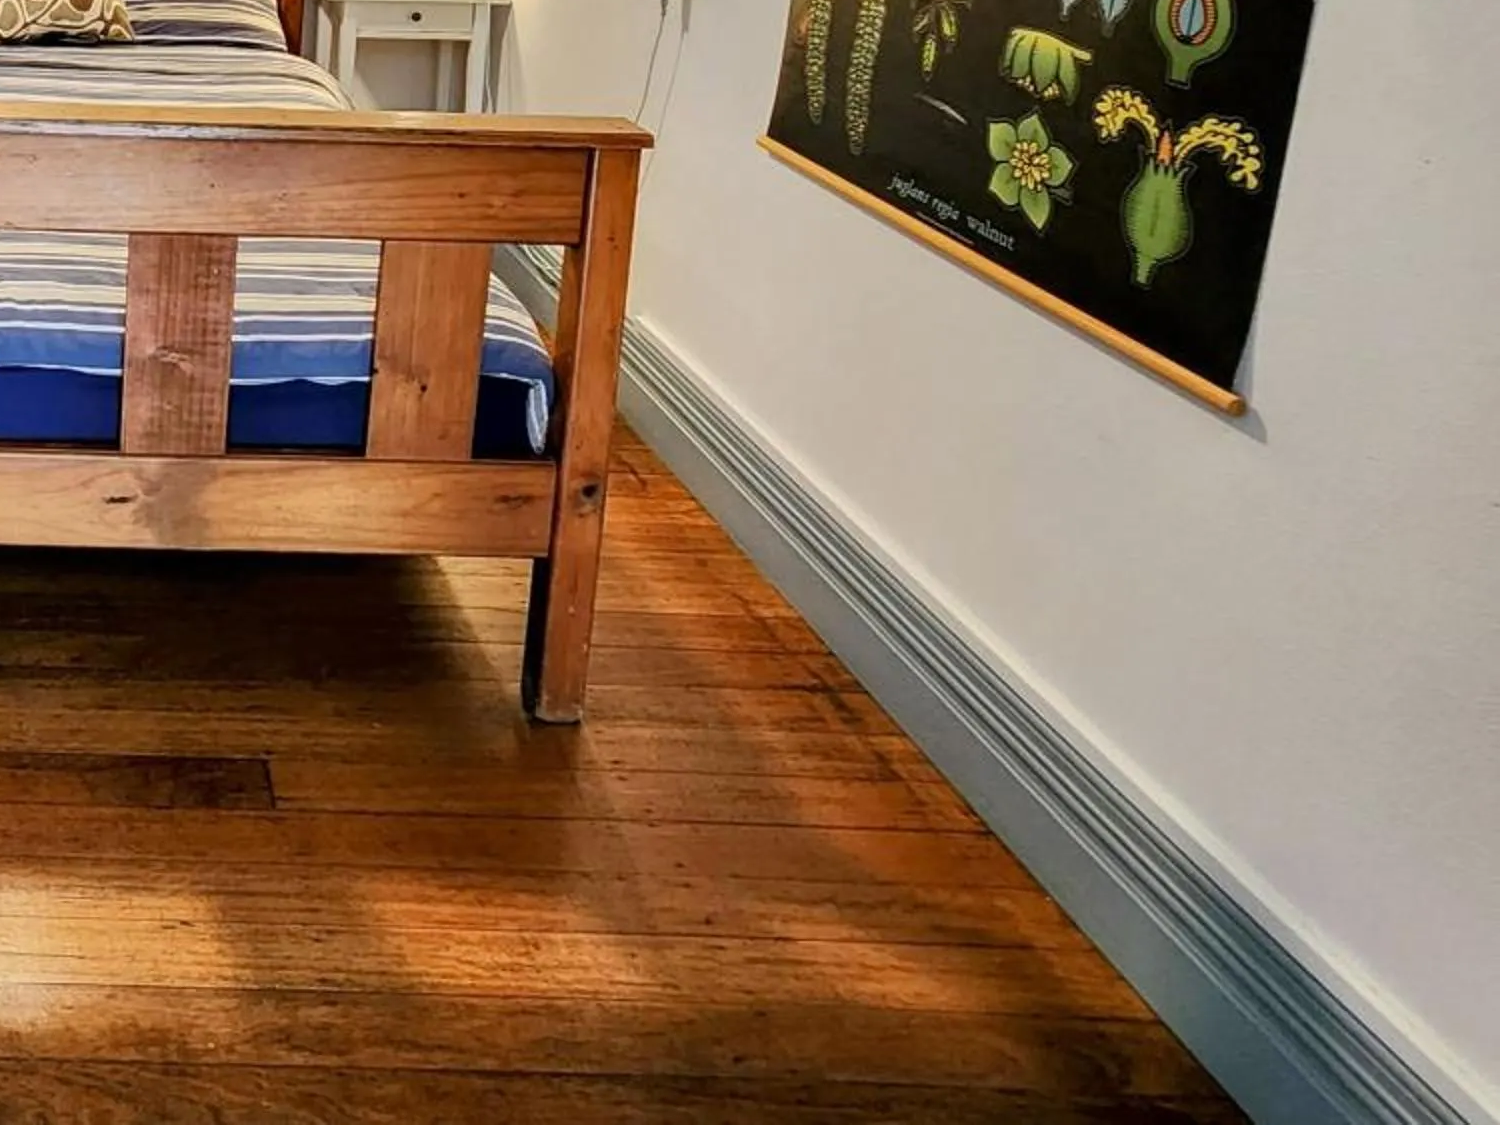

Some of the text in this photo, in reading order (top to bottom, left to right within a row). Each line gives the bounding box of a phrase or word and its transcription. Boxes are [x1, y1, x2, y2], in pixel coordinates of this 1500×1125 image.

[886, 172, 1017, 251] juglans regia walnut
